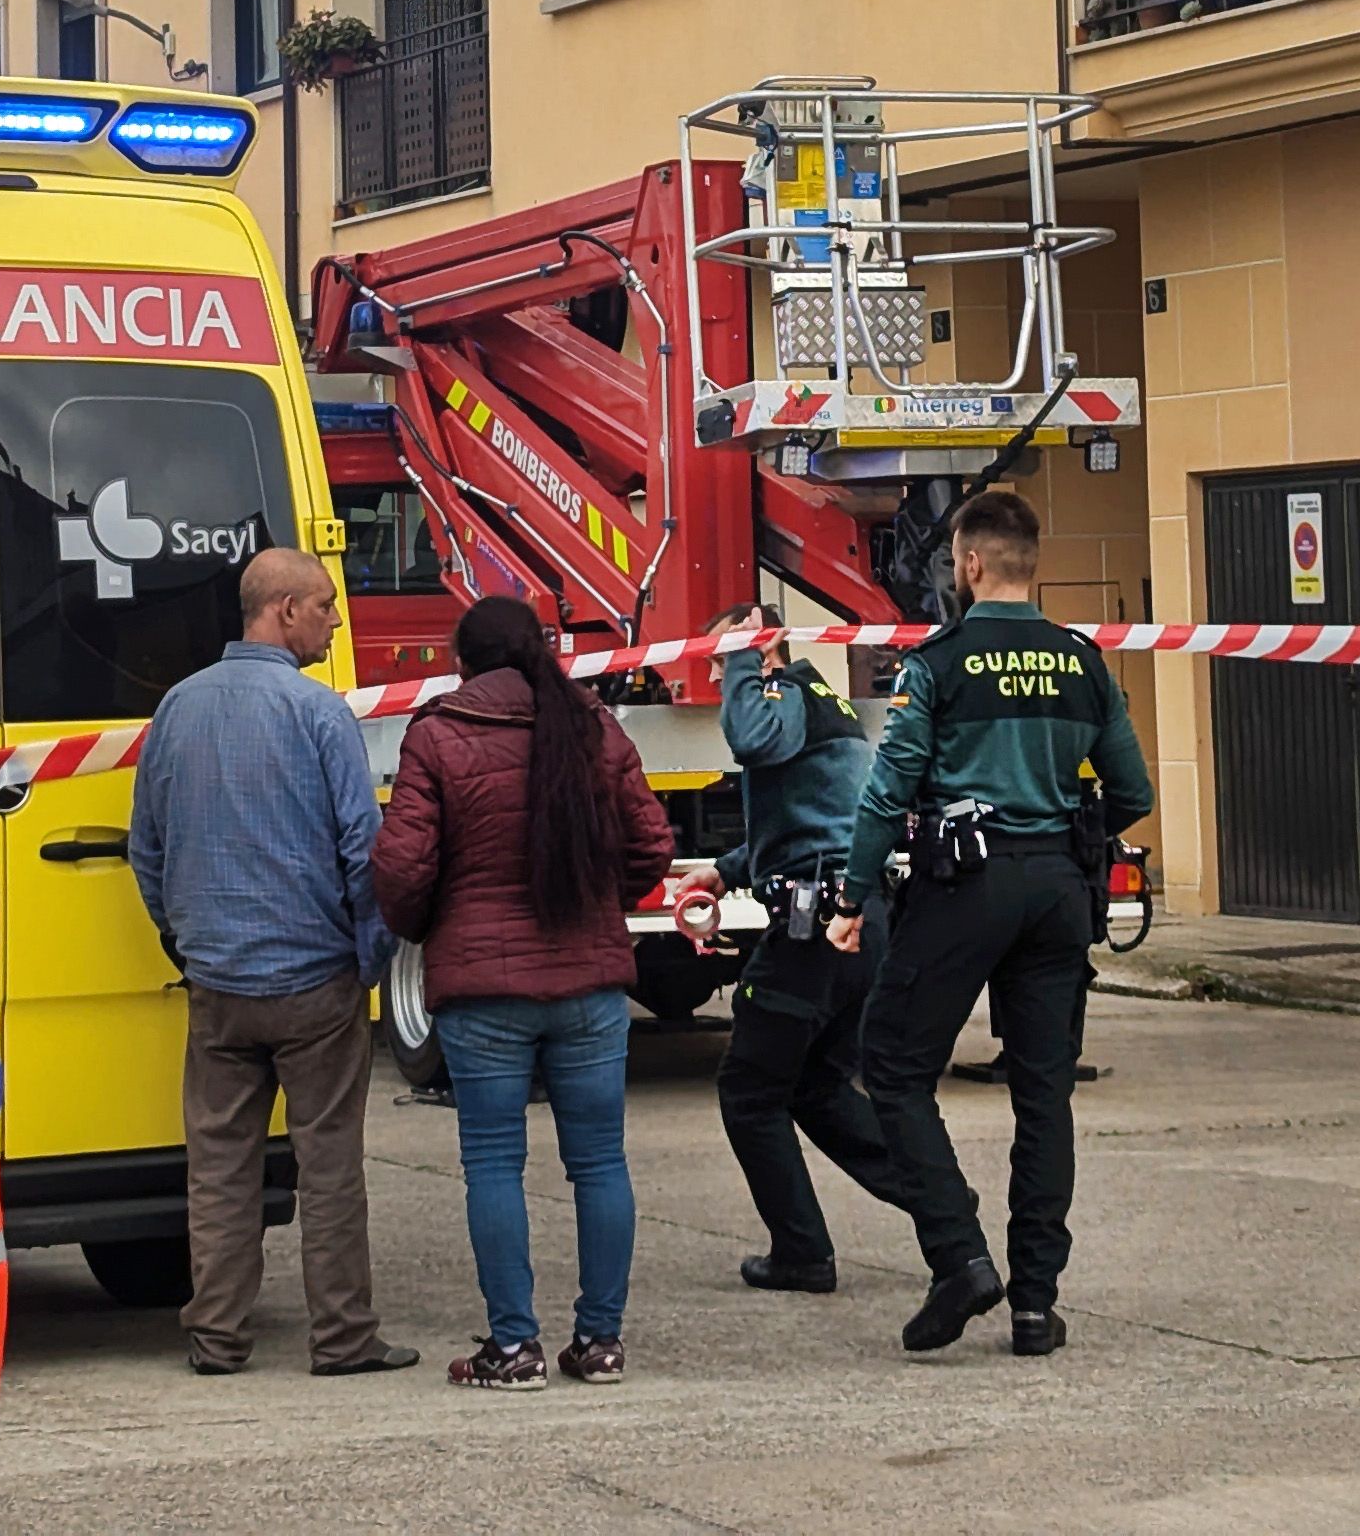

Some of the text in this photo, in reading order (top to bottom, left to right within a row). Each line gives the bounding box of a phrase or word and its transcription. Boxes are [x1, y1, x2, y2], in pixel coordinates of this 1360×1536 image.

[903, 397, 984, 415] Interreg
[491, 417, 582, 524] BOMBEROS
[171, 522, 256, 564] Sacyl
[964, 650, 1084, 676] GUARDIA
[998, 674, 1060, 697] CIVIL
